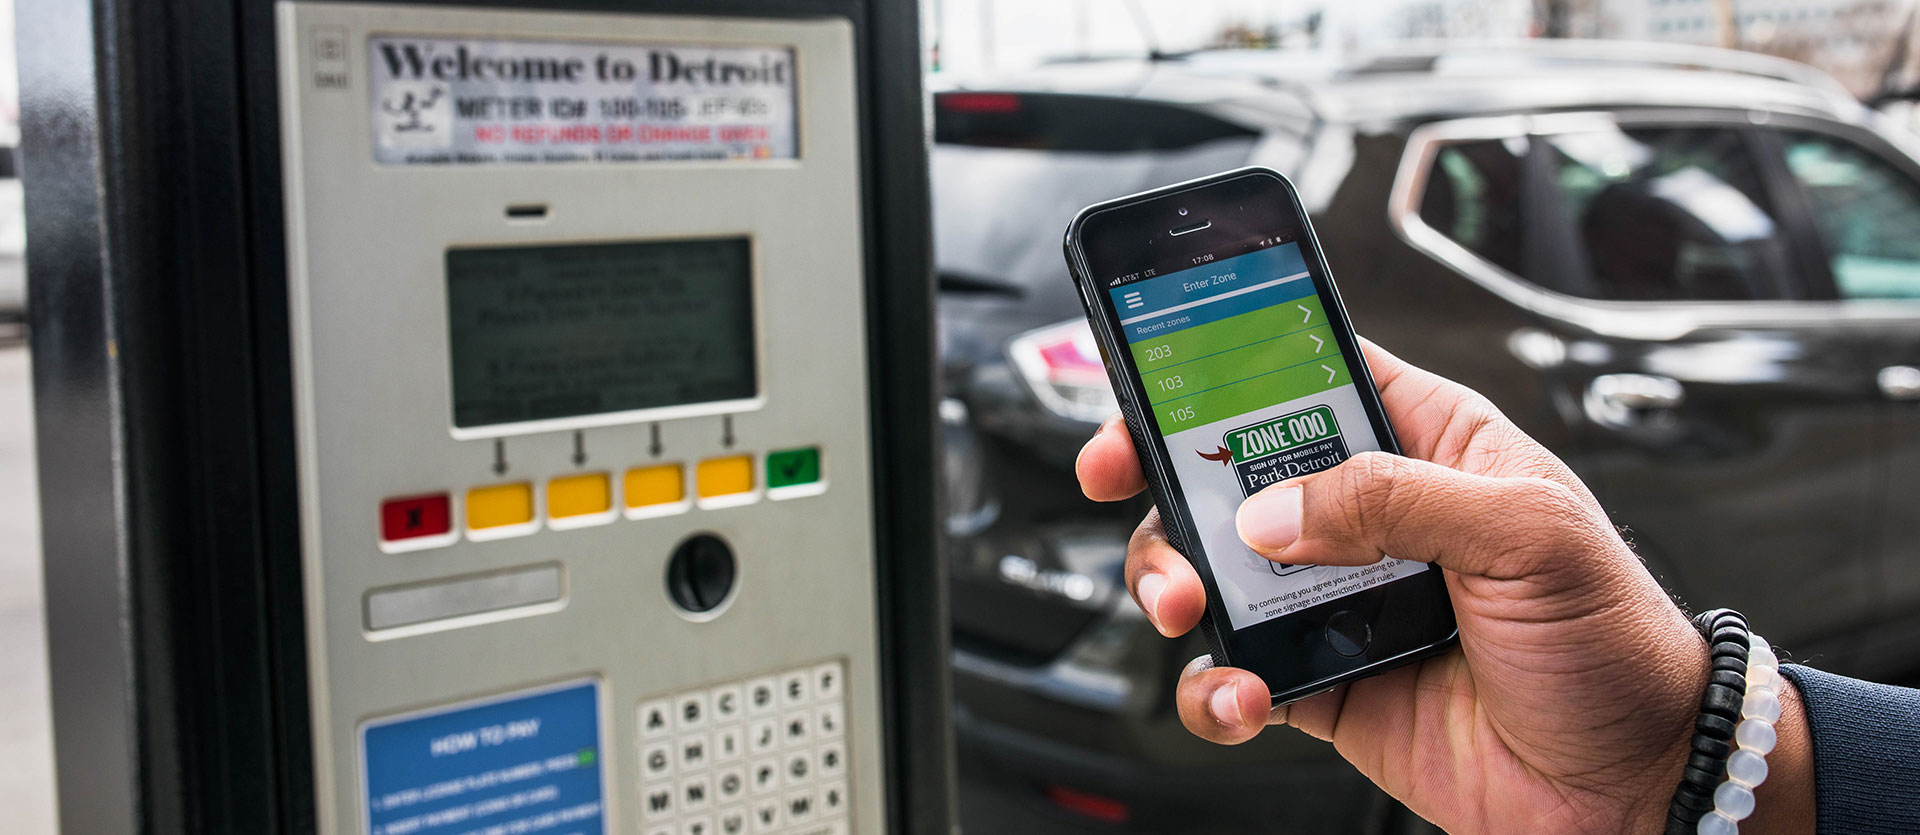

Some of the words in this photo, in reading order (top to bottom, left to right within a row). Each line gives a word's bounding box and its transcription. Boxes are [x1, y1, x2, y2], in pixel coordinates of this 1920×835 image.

[379, 42, 584, 81] Welcome
[596, 54, 635, 82] to
[649, 51, 785, 84] Detroit
[456, 96, 542, 118] METER
[474, 124, 506, 144] NO
[510, 124, 601, 145] REFUNDS
[605, 124, 633, 145] OR
[637, 124, 712, 145] CHANGE
[1192, 253, 1214, 265] 17:08
[1122, 272, 1140, 283] AT&T
[1144, 268, 1157, 278] LTE
[1183, 278, 1209, 293] Enter
[1210, 272, 1237, 286] Zone
[1136, 321, 1165, 335] Recent
[1167, 315, 1191, 328] zones
[1145, 344, 1172, 363] 203
[1157, 375, 1184, 393] 103
[1169, 405, 1196, 424] 105
[1236, 422, 1291, 458] ZONE
[1288, 411, 1328, 442] 000
[1249, 461, 1267, 472] SIGN
[1268, 458, 1278, 467] UP
[1279, 454, 1292, 464] FOR
[1293, 446, 1320, 460] MOBILE
[1320, 442, 1334, 452] PAY
[1248, 602, 1258, 612] By
[1259, 591, 1298, 609] continuing
[1297, 586, 1311, 598] you
[1312, 581, 1333, 593] agree
[1333, 576, 1347, 588] you
[1348, 571, 1360, 581] are
[1360, 563, 1387, 577] abiding
[1386, 561, 1395, 569] to
[1264, 607, 1283, 618] zone
[1283, 598, 1311, 614] signage
[1311, 595, 1322, 604] on
[1322, 582, 1362, 600] restrictions
[1362, 576, 1376, 587] and
[1377, 572, 1397, 583] rules.
[647, 709, 664, 729] A
[683, 701, 700, 722] B
[718, 693, 735, 714] C
[754, 686, 770, 706] D
[788, 679, 800, 699] E
[430, 730, 478, 757] HOW
[479, 724, 505, 747] TO
[505, 717, 541, 741] PAY
[648, 750, 667, 771] G
[685, 744, 703, 763] H
[725, 735, 734, 753] I
[759, 727, 772, 746] J
[789, 719, 805, 737] K
[822, 713, 834, 731] L
[686, 784, 704, 803] N
[721, 773, 740, 795] O
[757, 765, 773, 785] P
[724, 815, 742, 834] U
[759, 807, 775, 825] V
